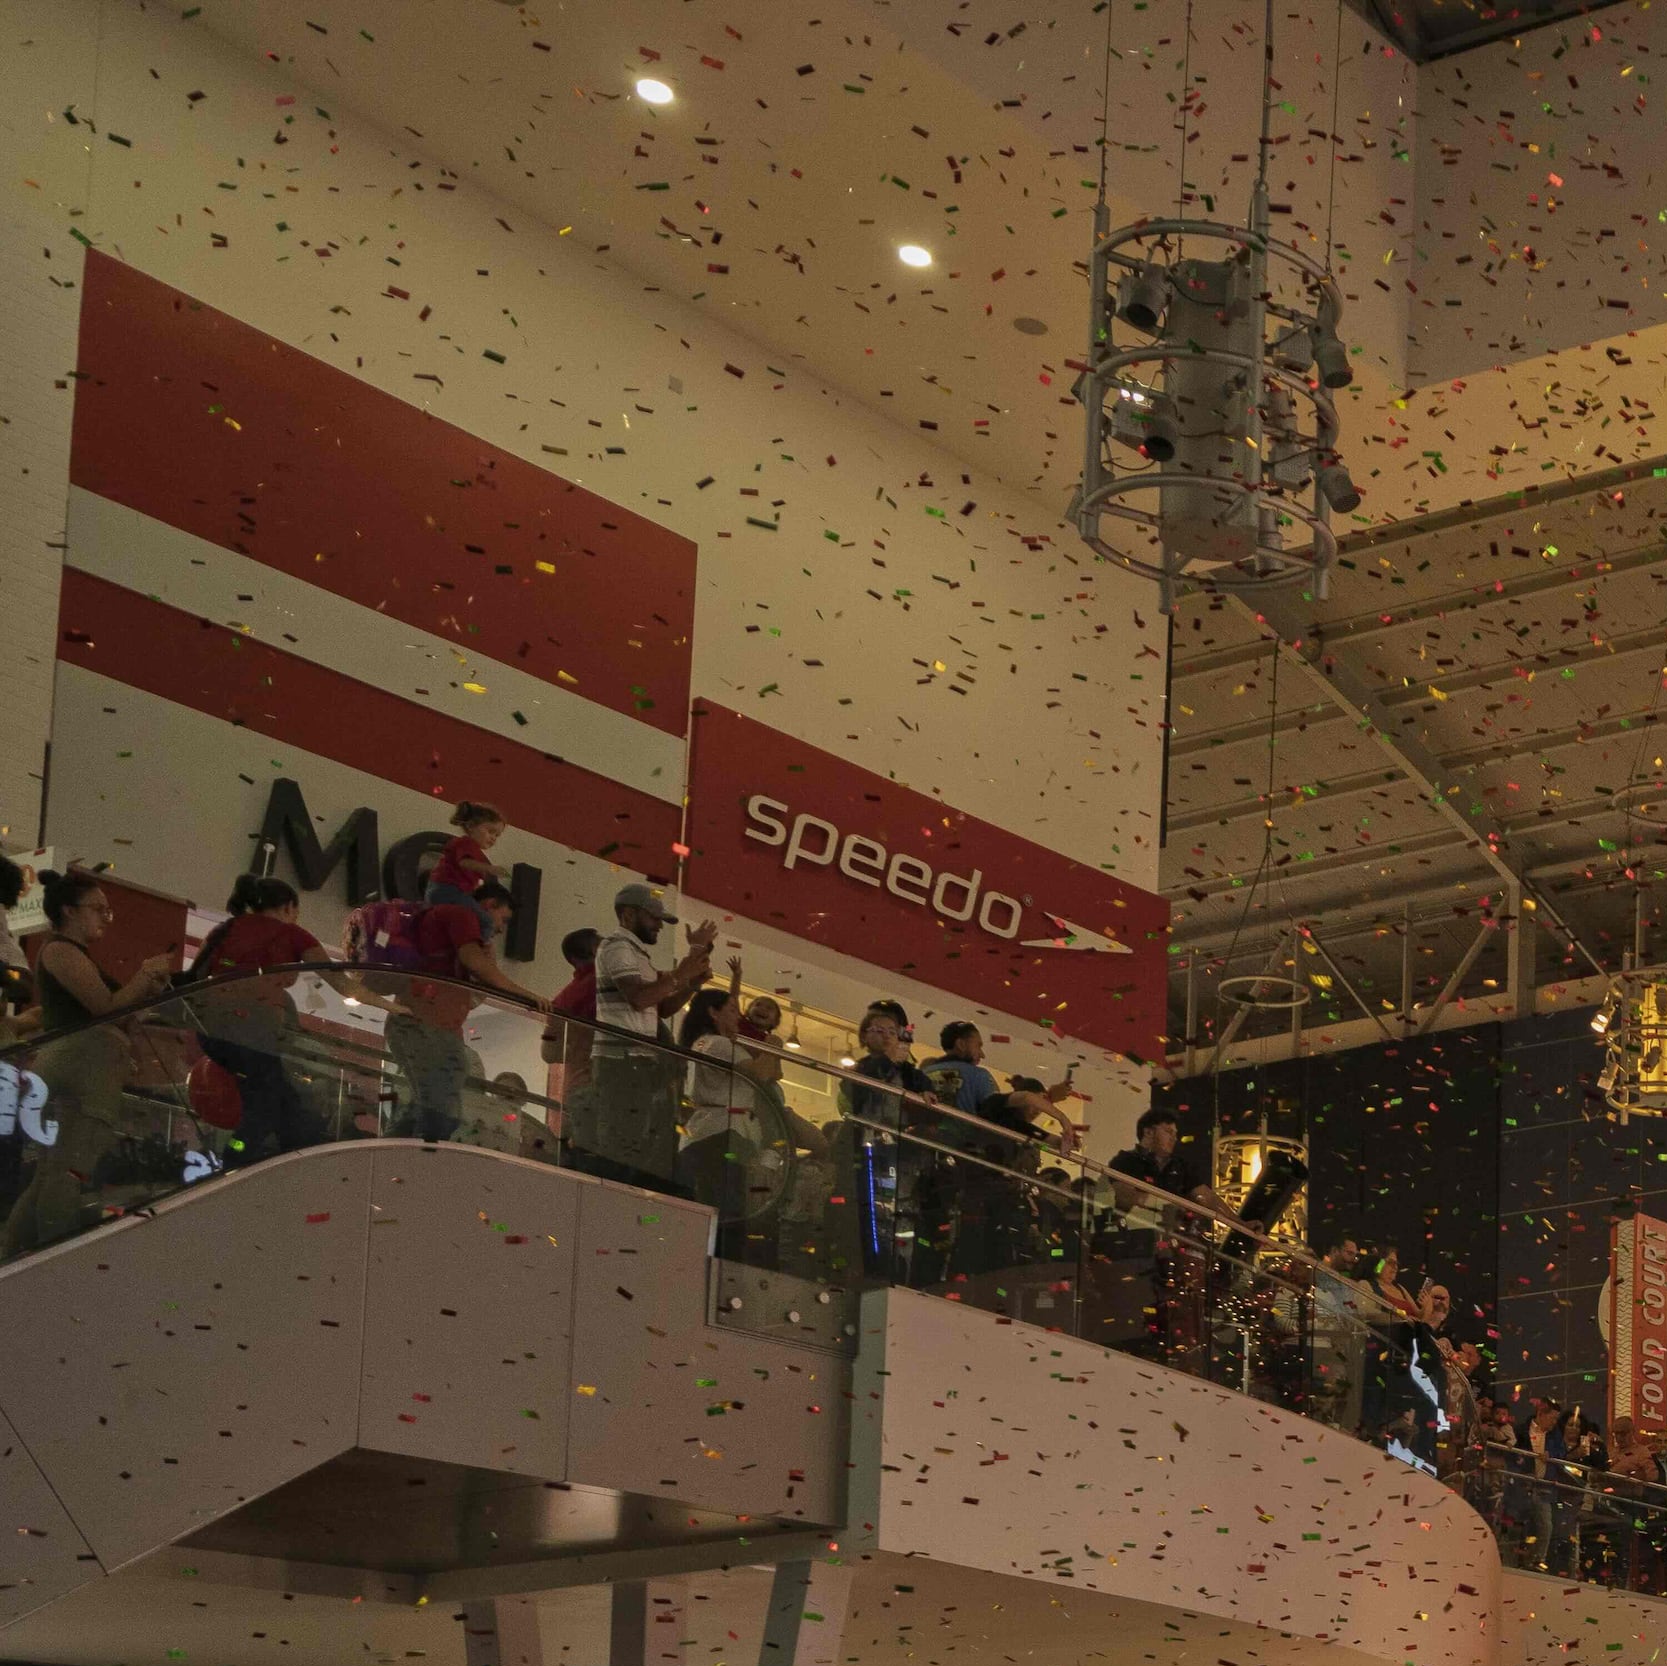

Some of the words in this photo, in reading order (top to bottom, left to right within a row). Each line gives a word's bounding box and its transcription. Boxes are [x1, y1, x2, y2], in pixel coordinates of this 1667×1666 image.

[745, 794, 1023, 939] speedo
[1641, 1224, 1667, 1327] COURT
[1641, 1337, 1665, 1423] FOOD
